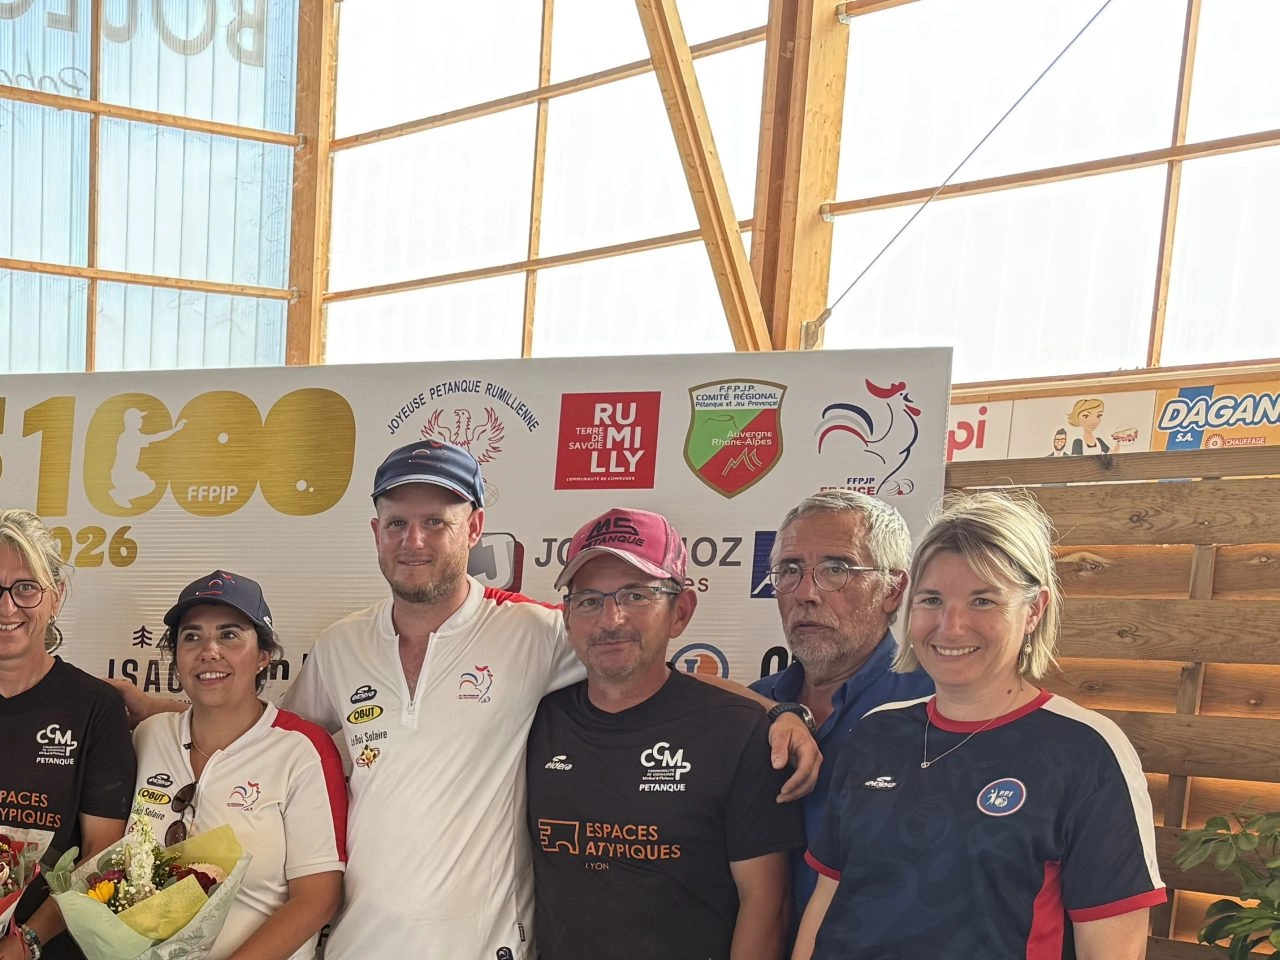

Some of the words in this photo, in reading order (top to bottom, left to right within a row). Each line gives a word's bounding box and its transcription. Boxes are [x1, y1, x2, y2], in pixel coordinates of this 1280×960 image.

[696, 392, 730, 401] COMITÉ
[734, 392, 778, 401] RÉGIONAL
[387, 393, 426, 435] JOYEUSE
[429, 380, 481, 400] PETANQUE
[484, 382, 540, 432] RUMILLIENNE
[576, 427, 604, 435] TERRE
[727, 430, 772, 439] Auvergne
[591, 434, 604, 442] DE
[1225, 437, 1266, 447] CHAUFFAGE
[568, 442, 603, 450] SAVOIE
[847, 477, 875, 485] FFPJP
[187, 485, 239, 504] FFPJP
[49, 526, 138, 567] 026
[354, 707, 375, 720] OBUT
[364, 730, 388, 743] Solaire
[36, 757, 74, 765] PETANQUE
[639, 783, 686, 792] PETANQUE
[141, 790, 165, 802] OBUT
[144, 807, 165, 820] Solaire
[586, 822, 658, 840] ESPACES
[586, 841, 681, 860] ATYPIQUES
